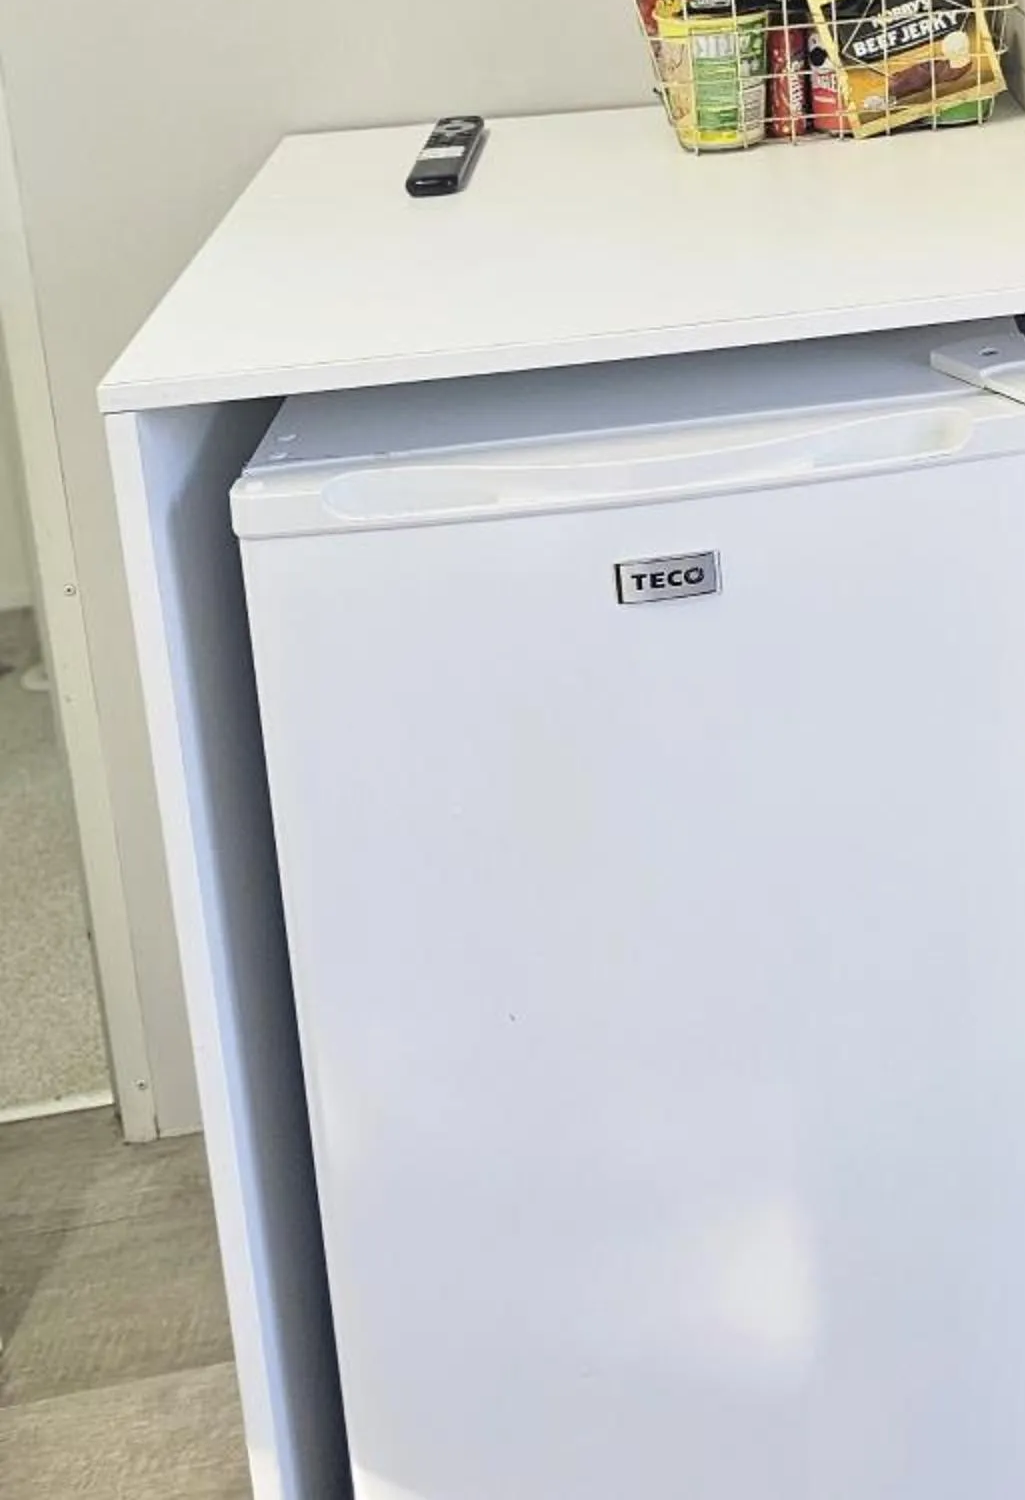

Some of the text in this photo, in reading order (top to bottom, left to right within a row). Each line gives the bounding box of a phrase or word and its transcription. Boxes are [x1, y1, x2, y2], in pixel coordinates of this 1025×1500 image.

[852, 10, 959, 57] BEEF JERKY
[631, 567, 705, 590] TECO
